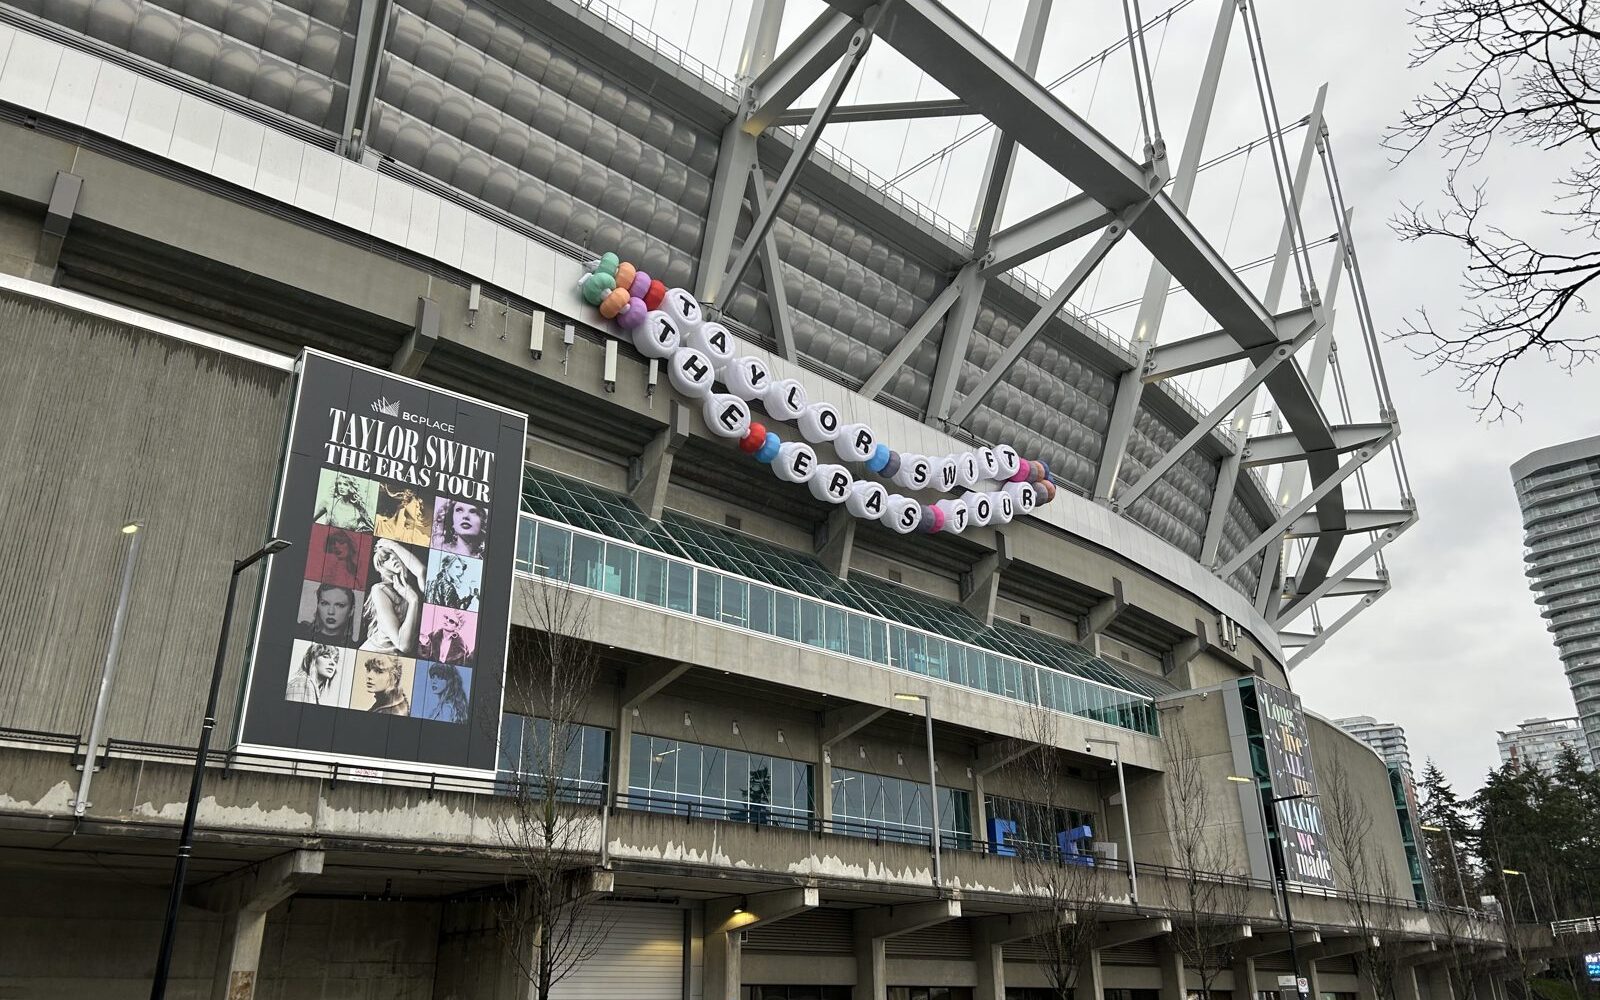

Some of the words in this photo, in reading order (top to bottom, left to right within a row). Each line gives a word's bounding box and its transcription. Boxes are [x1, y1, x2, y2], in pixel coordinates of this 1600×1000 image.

[677, 294, 873, 454] TAYLOR
[914, 450, 1016, 487] SWIFT
[329, 407, 419, 464] TAYLOR
[424, 434, 495, 483] SWIFT
[658, 317, 745, 431] THE
[792, 453, 916, 527] ERAS
[955, 488, 1033, 528] TOUR
[324, 442, 371, 472] THE
[374, 456, 431, 488] ERAS
[435, 471, 491, 503] TOUR
[1262, 692, 1295, 734] Long
[1279, 799, 1323, 836] MAGIC
[1295, 849, 1332, 881] made
[1296, 831, 1315, 856] we
